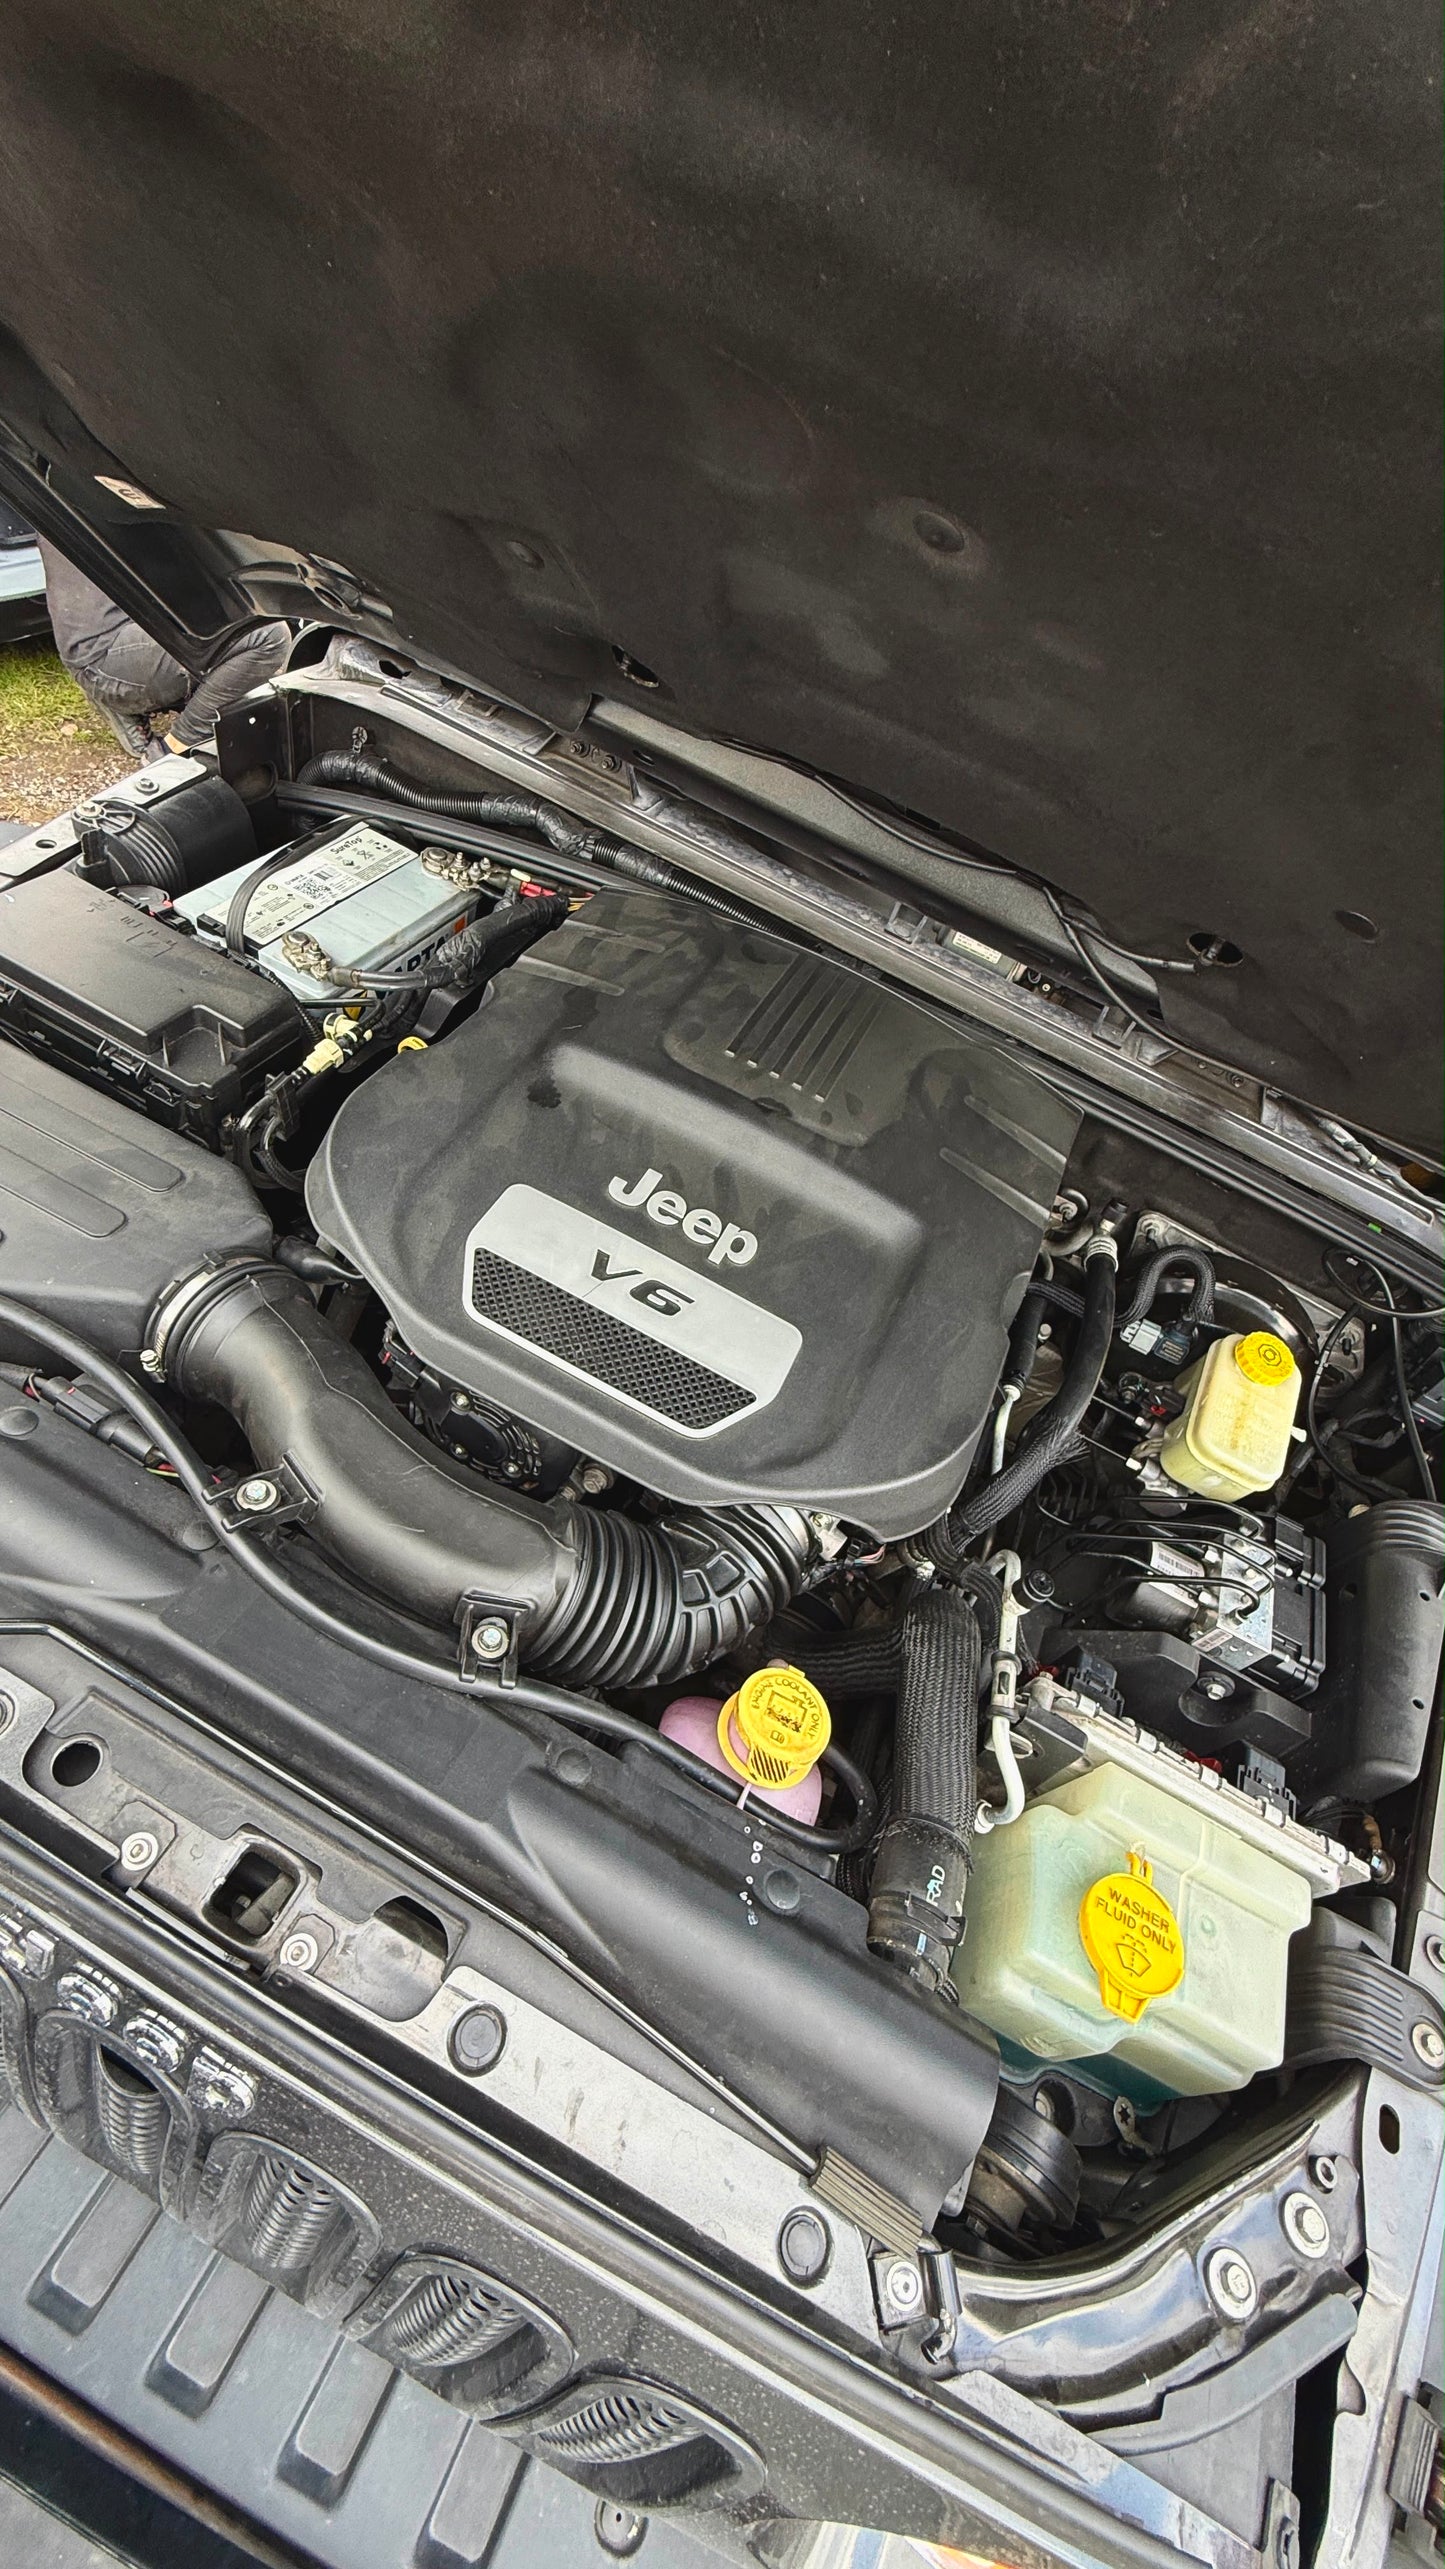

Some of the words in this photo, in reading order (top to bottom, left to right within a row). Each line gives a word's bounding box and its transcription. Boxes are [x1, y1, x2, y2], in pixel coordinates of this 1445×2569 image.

[330, 836, 363, 855] SureTop
[608, 1168, 758, 1265] Jeep
[591, 1249, 696, 1316] V6
[752, 1681, 773, 1709] ENGINE
[775, 1679, 817, 1709] COOLANT
[808, 1714, 820, 1739] ONLY
[926, 1864, 946, 1907] RAD
[1108, 1886, 1170, 1933] WASHER
[1095, 1895, 1137, 1930] FLUID
[1140, 1924, 1177, 1954] ONLY
